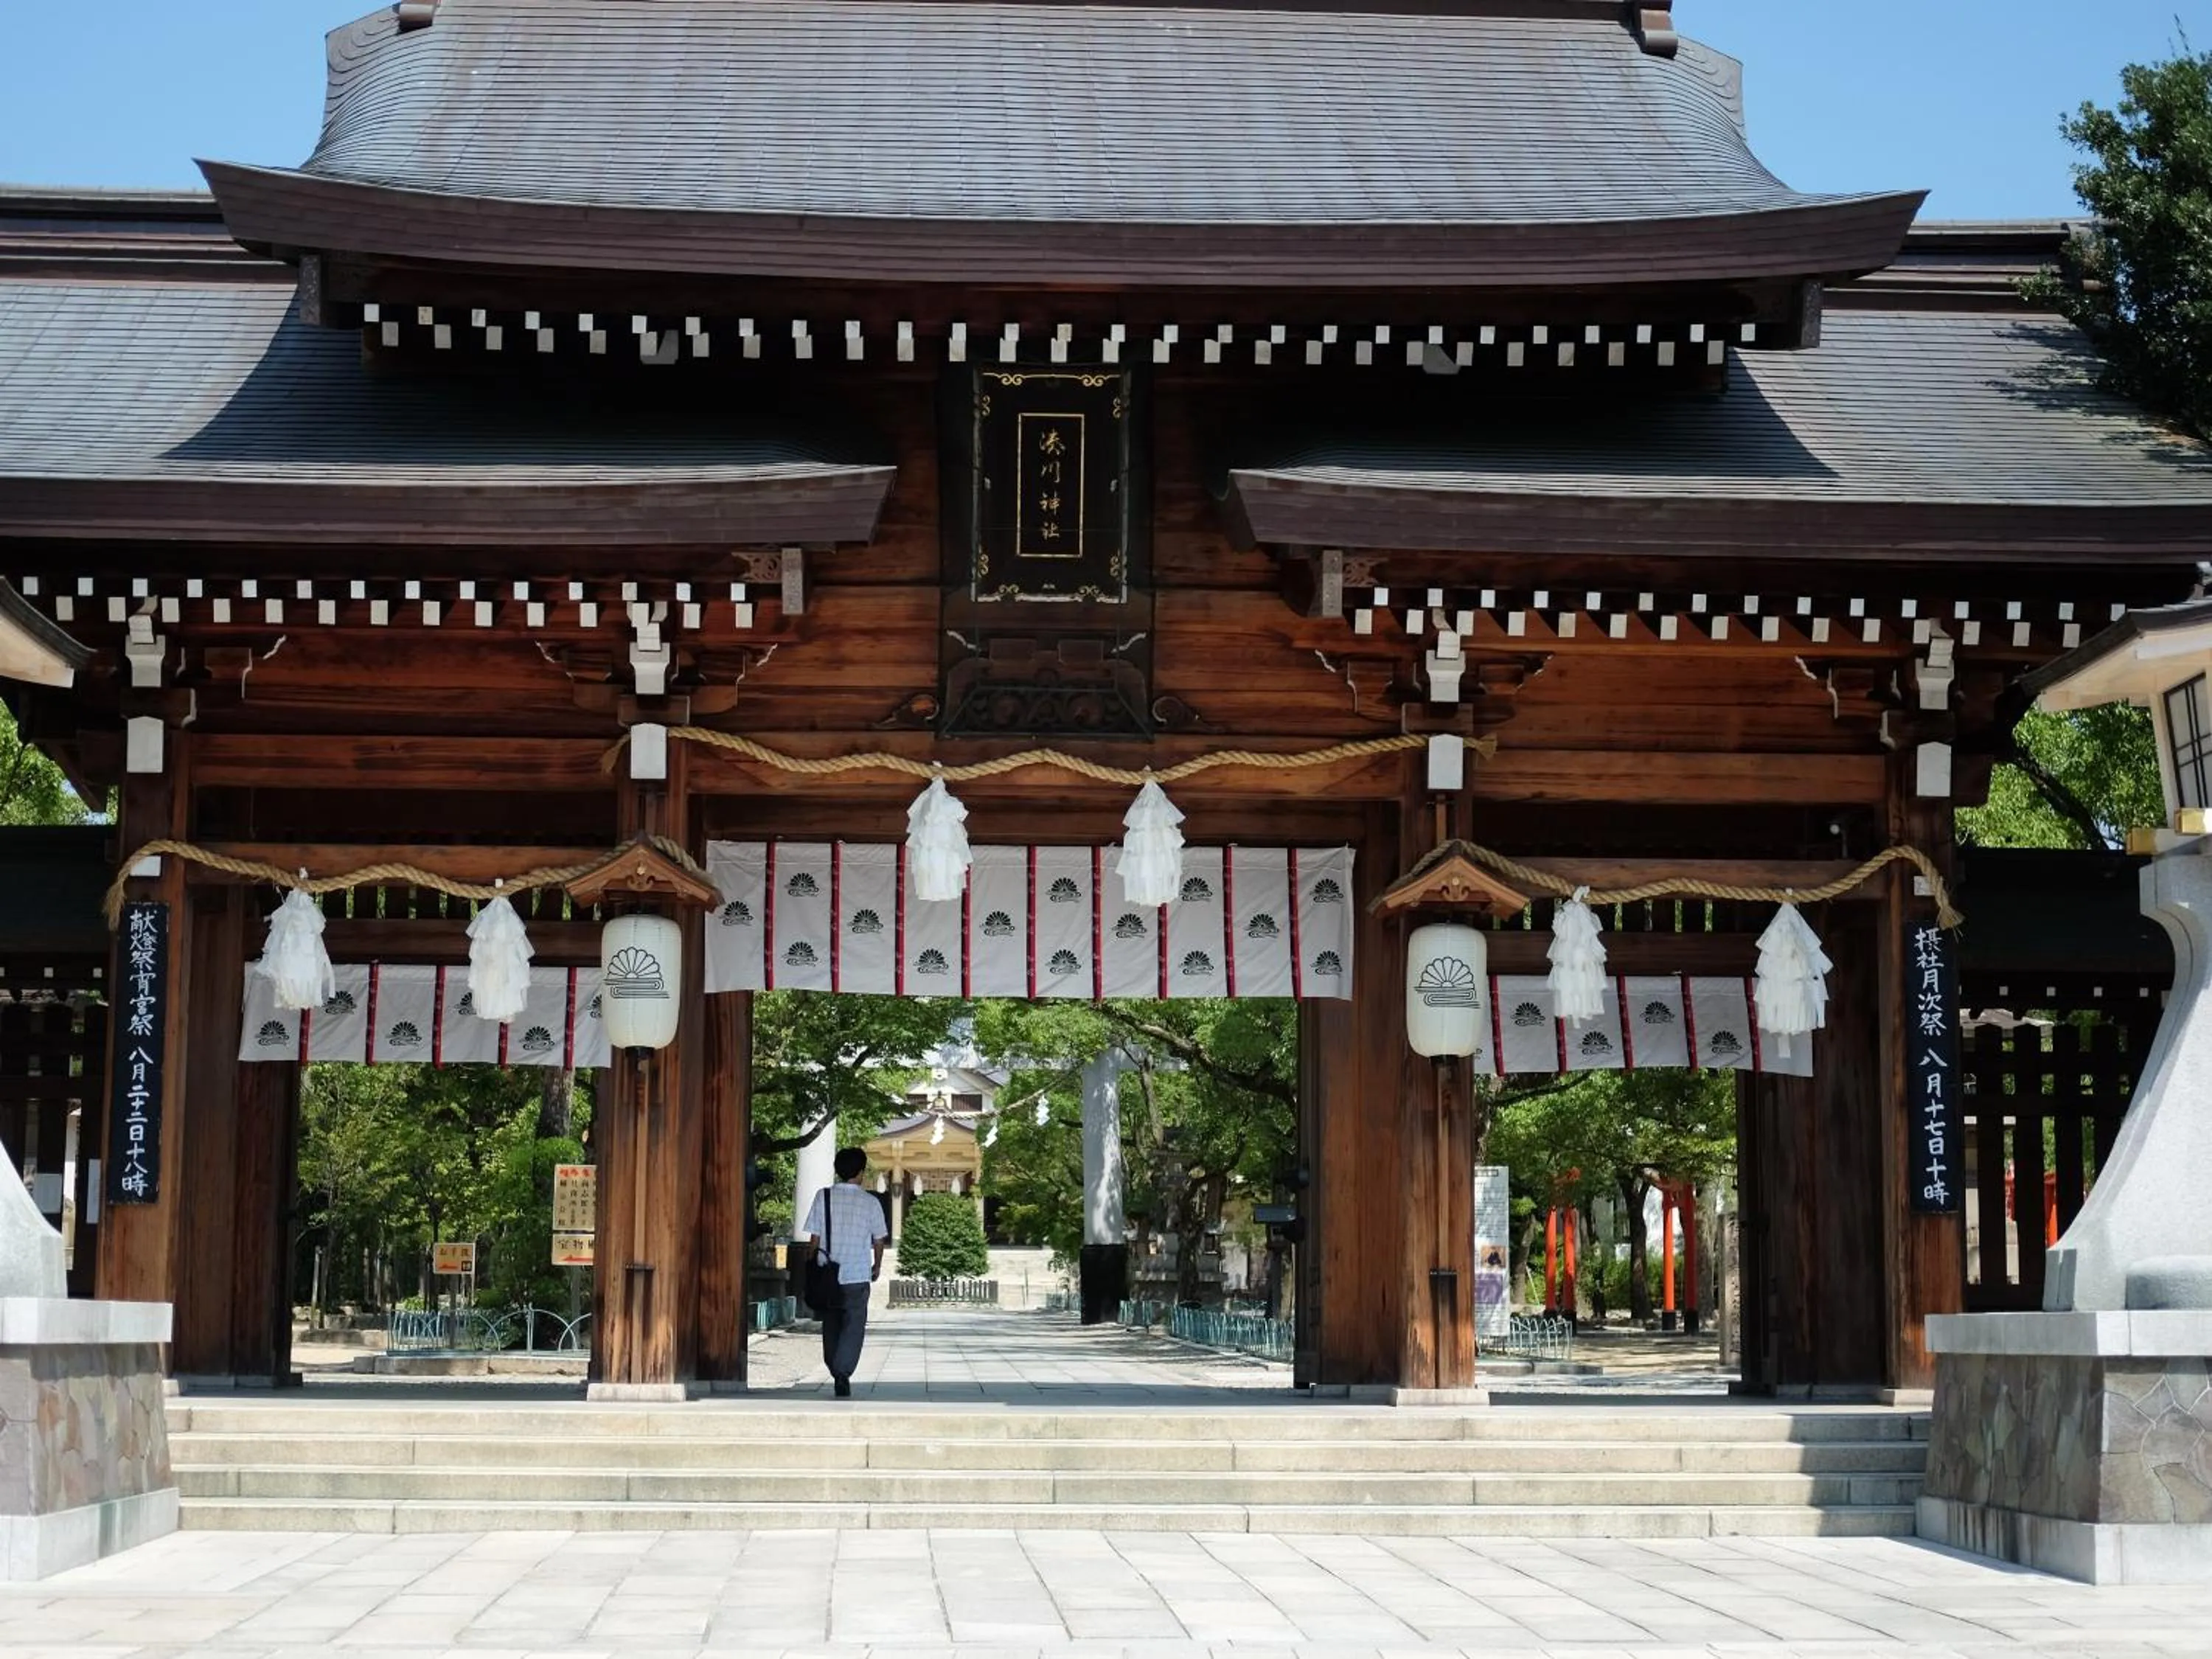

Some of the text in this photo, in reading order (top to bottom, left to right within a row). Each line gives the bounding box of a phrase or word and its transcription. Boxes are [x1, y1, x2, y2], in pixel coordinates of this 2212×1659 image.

[1038, 428, 1066, 540] 湊川神社
[122, 1046, 154, 1197] 八月二十二日十八時
[1918, 1047, 1950, 1205] 八月十七日十時
